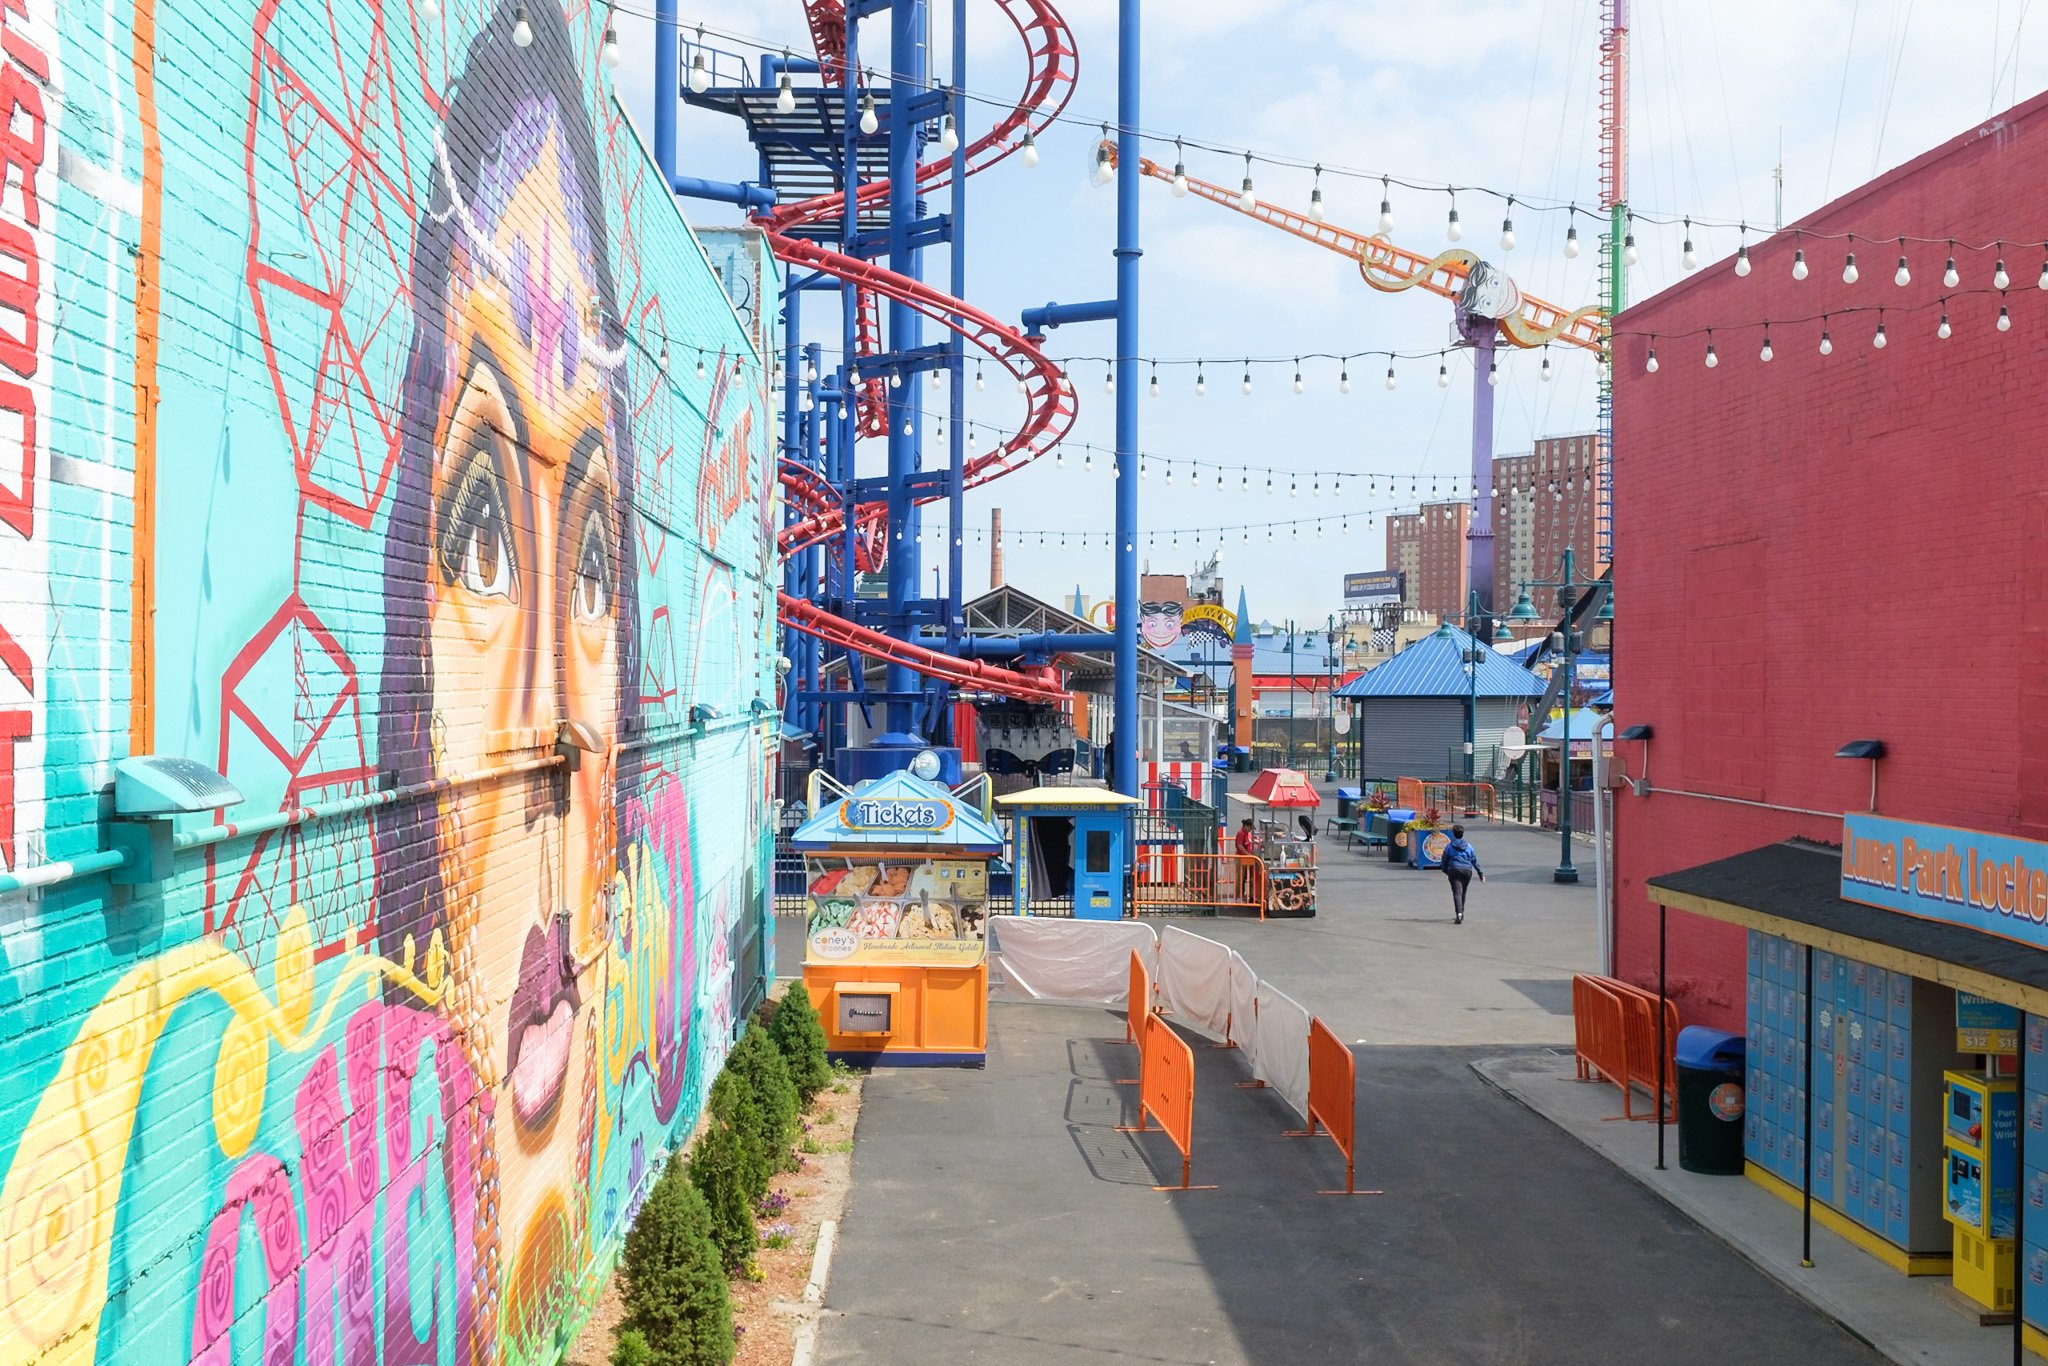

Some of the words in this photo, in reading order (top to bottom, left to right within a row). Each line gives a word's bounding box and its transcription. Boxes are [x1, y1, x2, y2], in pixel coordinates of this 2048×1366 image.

[860, 801, 935, 827] Tickets
[1843, 826, 1897, 891] Luna
[1901, 836, 1965, 904] Park
[1968, 847, 2048, 927] Locke
[815, 935, 855, 946] coney's
[1966, 1037, 1988, 1047] $12
[1992, 1120, 2012, 1129] Your
